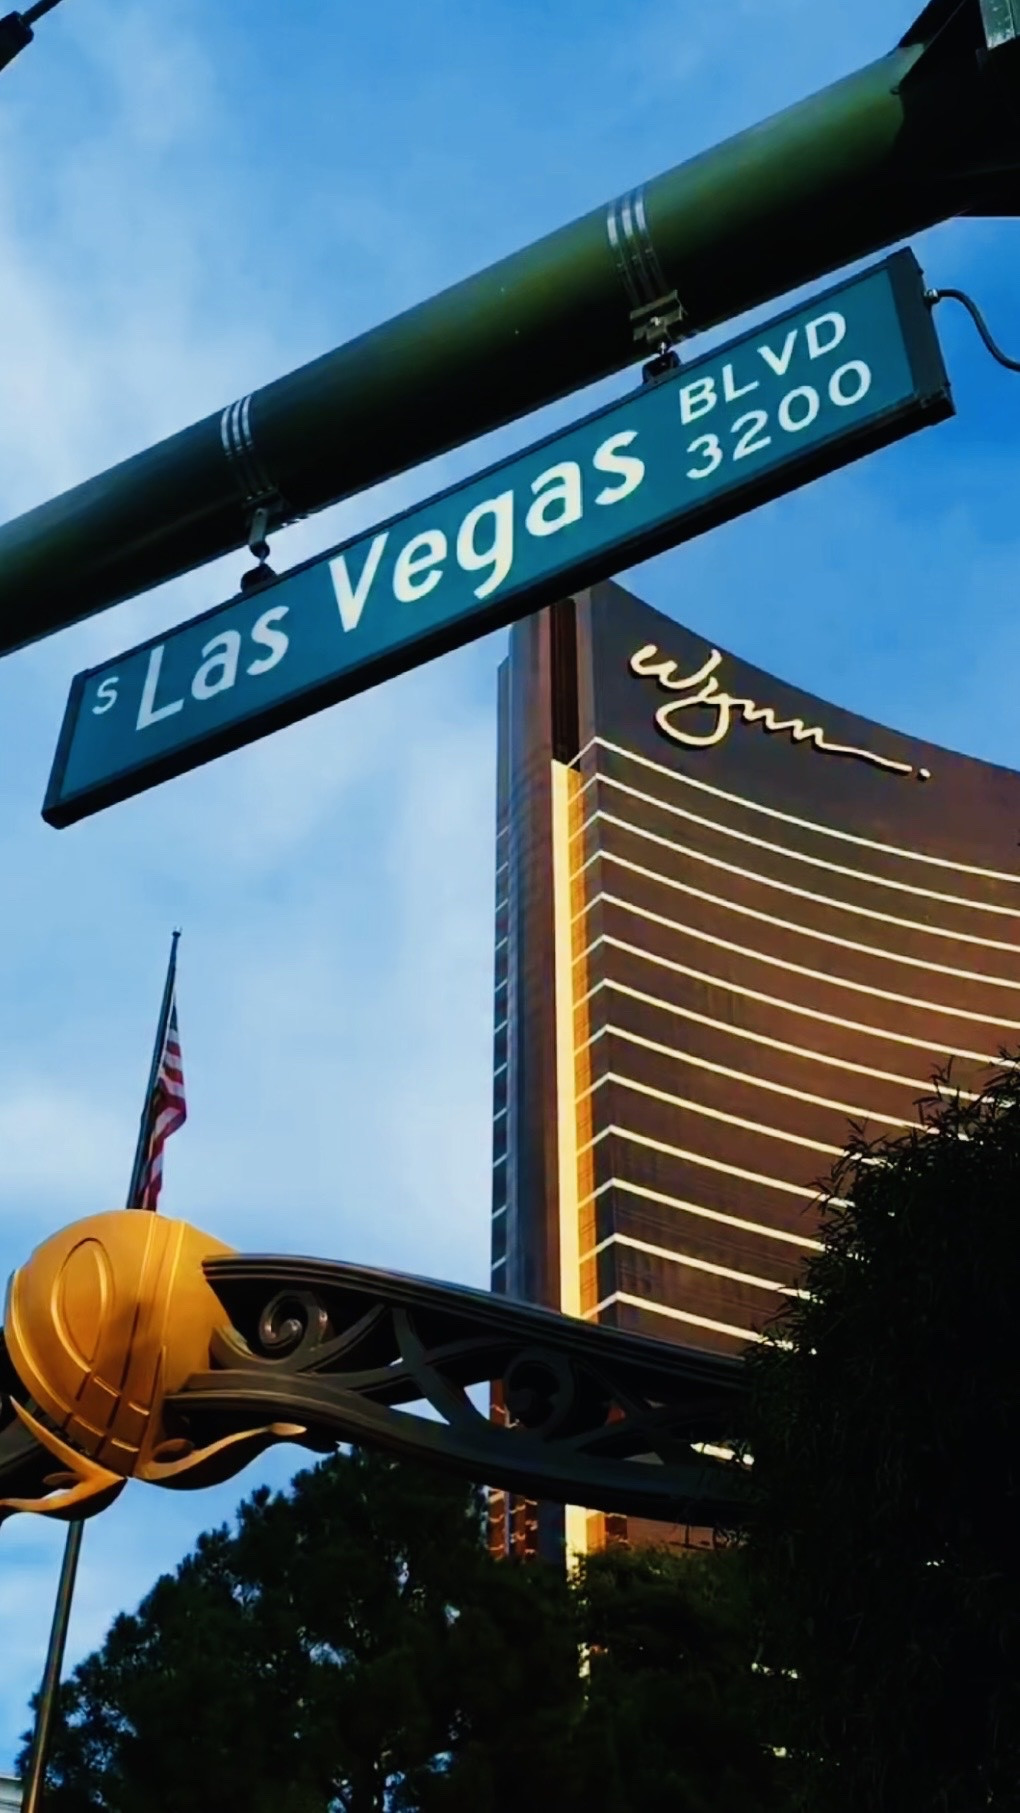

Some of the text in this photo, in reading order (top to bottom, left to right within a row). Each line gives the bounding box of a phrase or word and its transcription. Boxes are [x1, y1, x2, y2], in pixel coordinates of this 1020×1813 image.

[678, 312, 847, 426] BLVD
[687, 359, 871, 480] 3200
[93, 430, 646, 731] S Las Vegas
